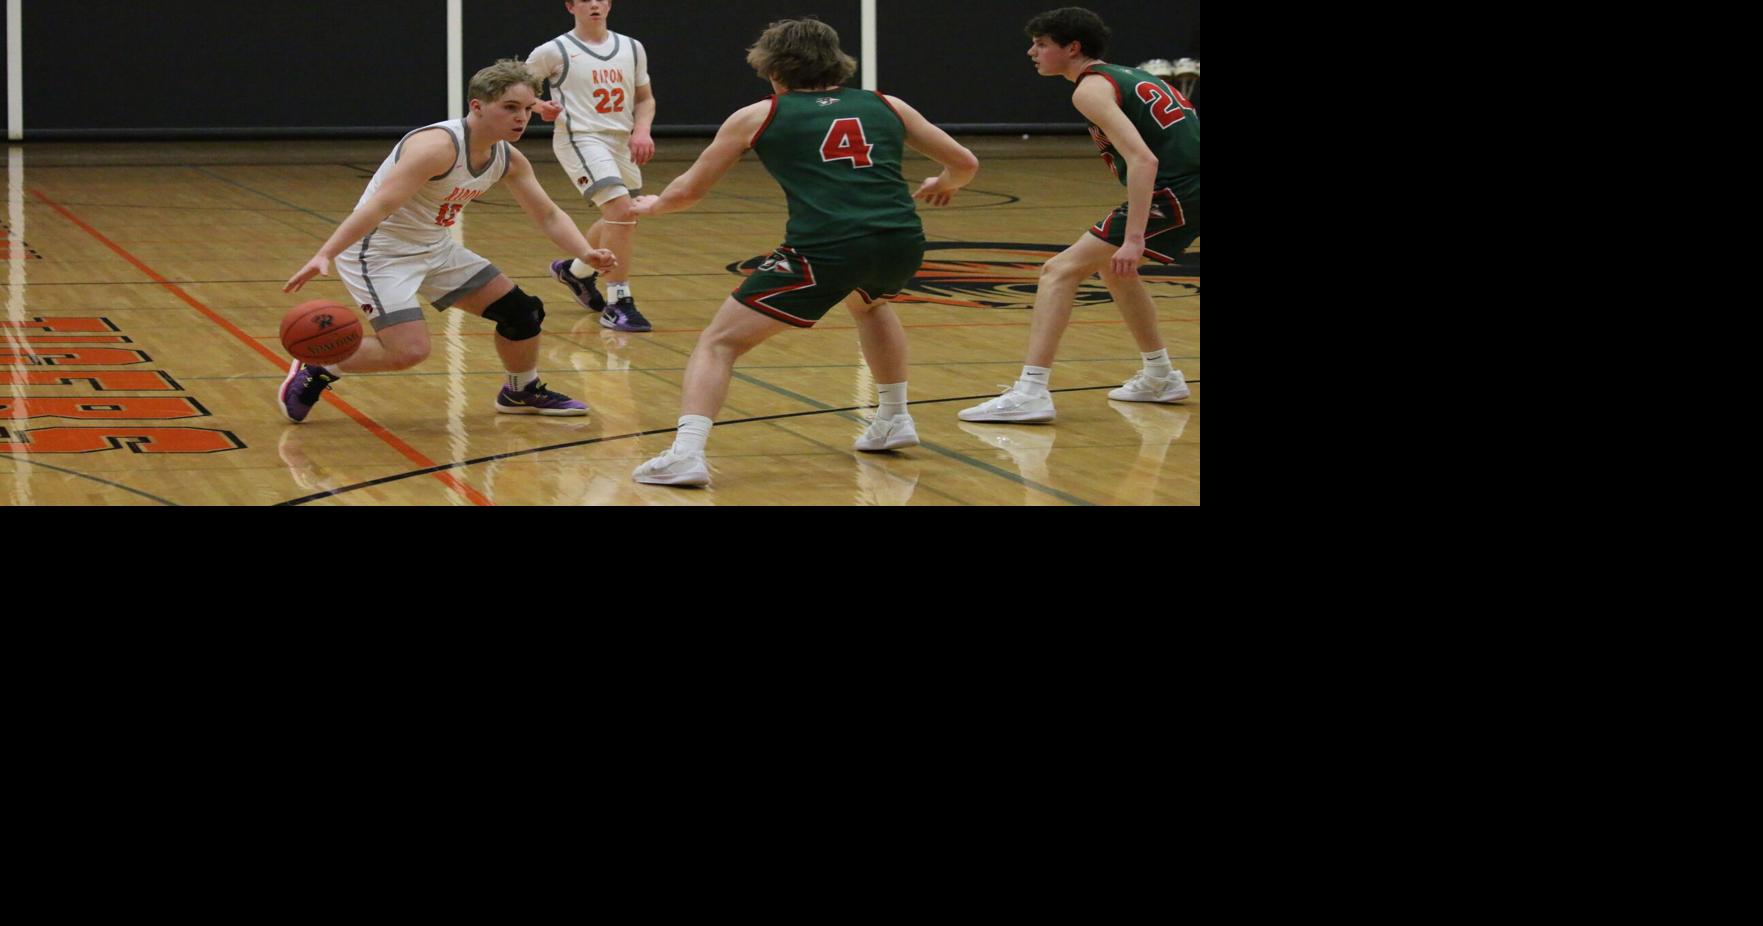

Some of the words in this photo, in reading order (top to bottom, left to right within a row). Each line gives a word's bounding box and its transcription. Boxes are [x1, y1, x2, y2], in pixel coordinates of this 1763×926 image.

[592, 69, 624, 84] RIPON
[592, 87, 625, 113] 22
[819, 117, 874, 169] 4
